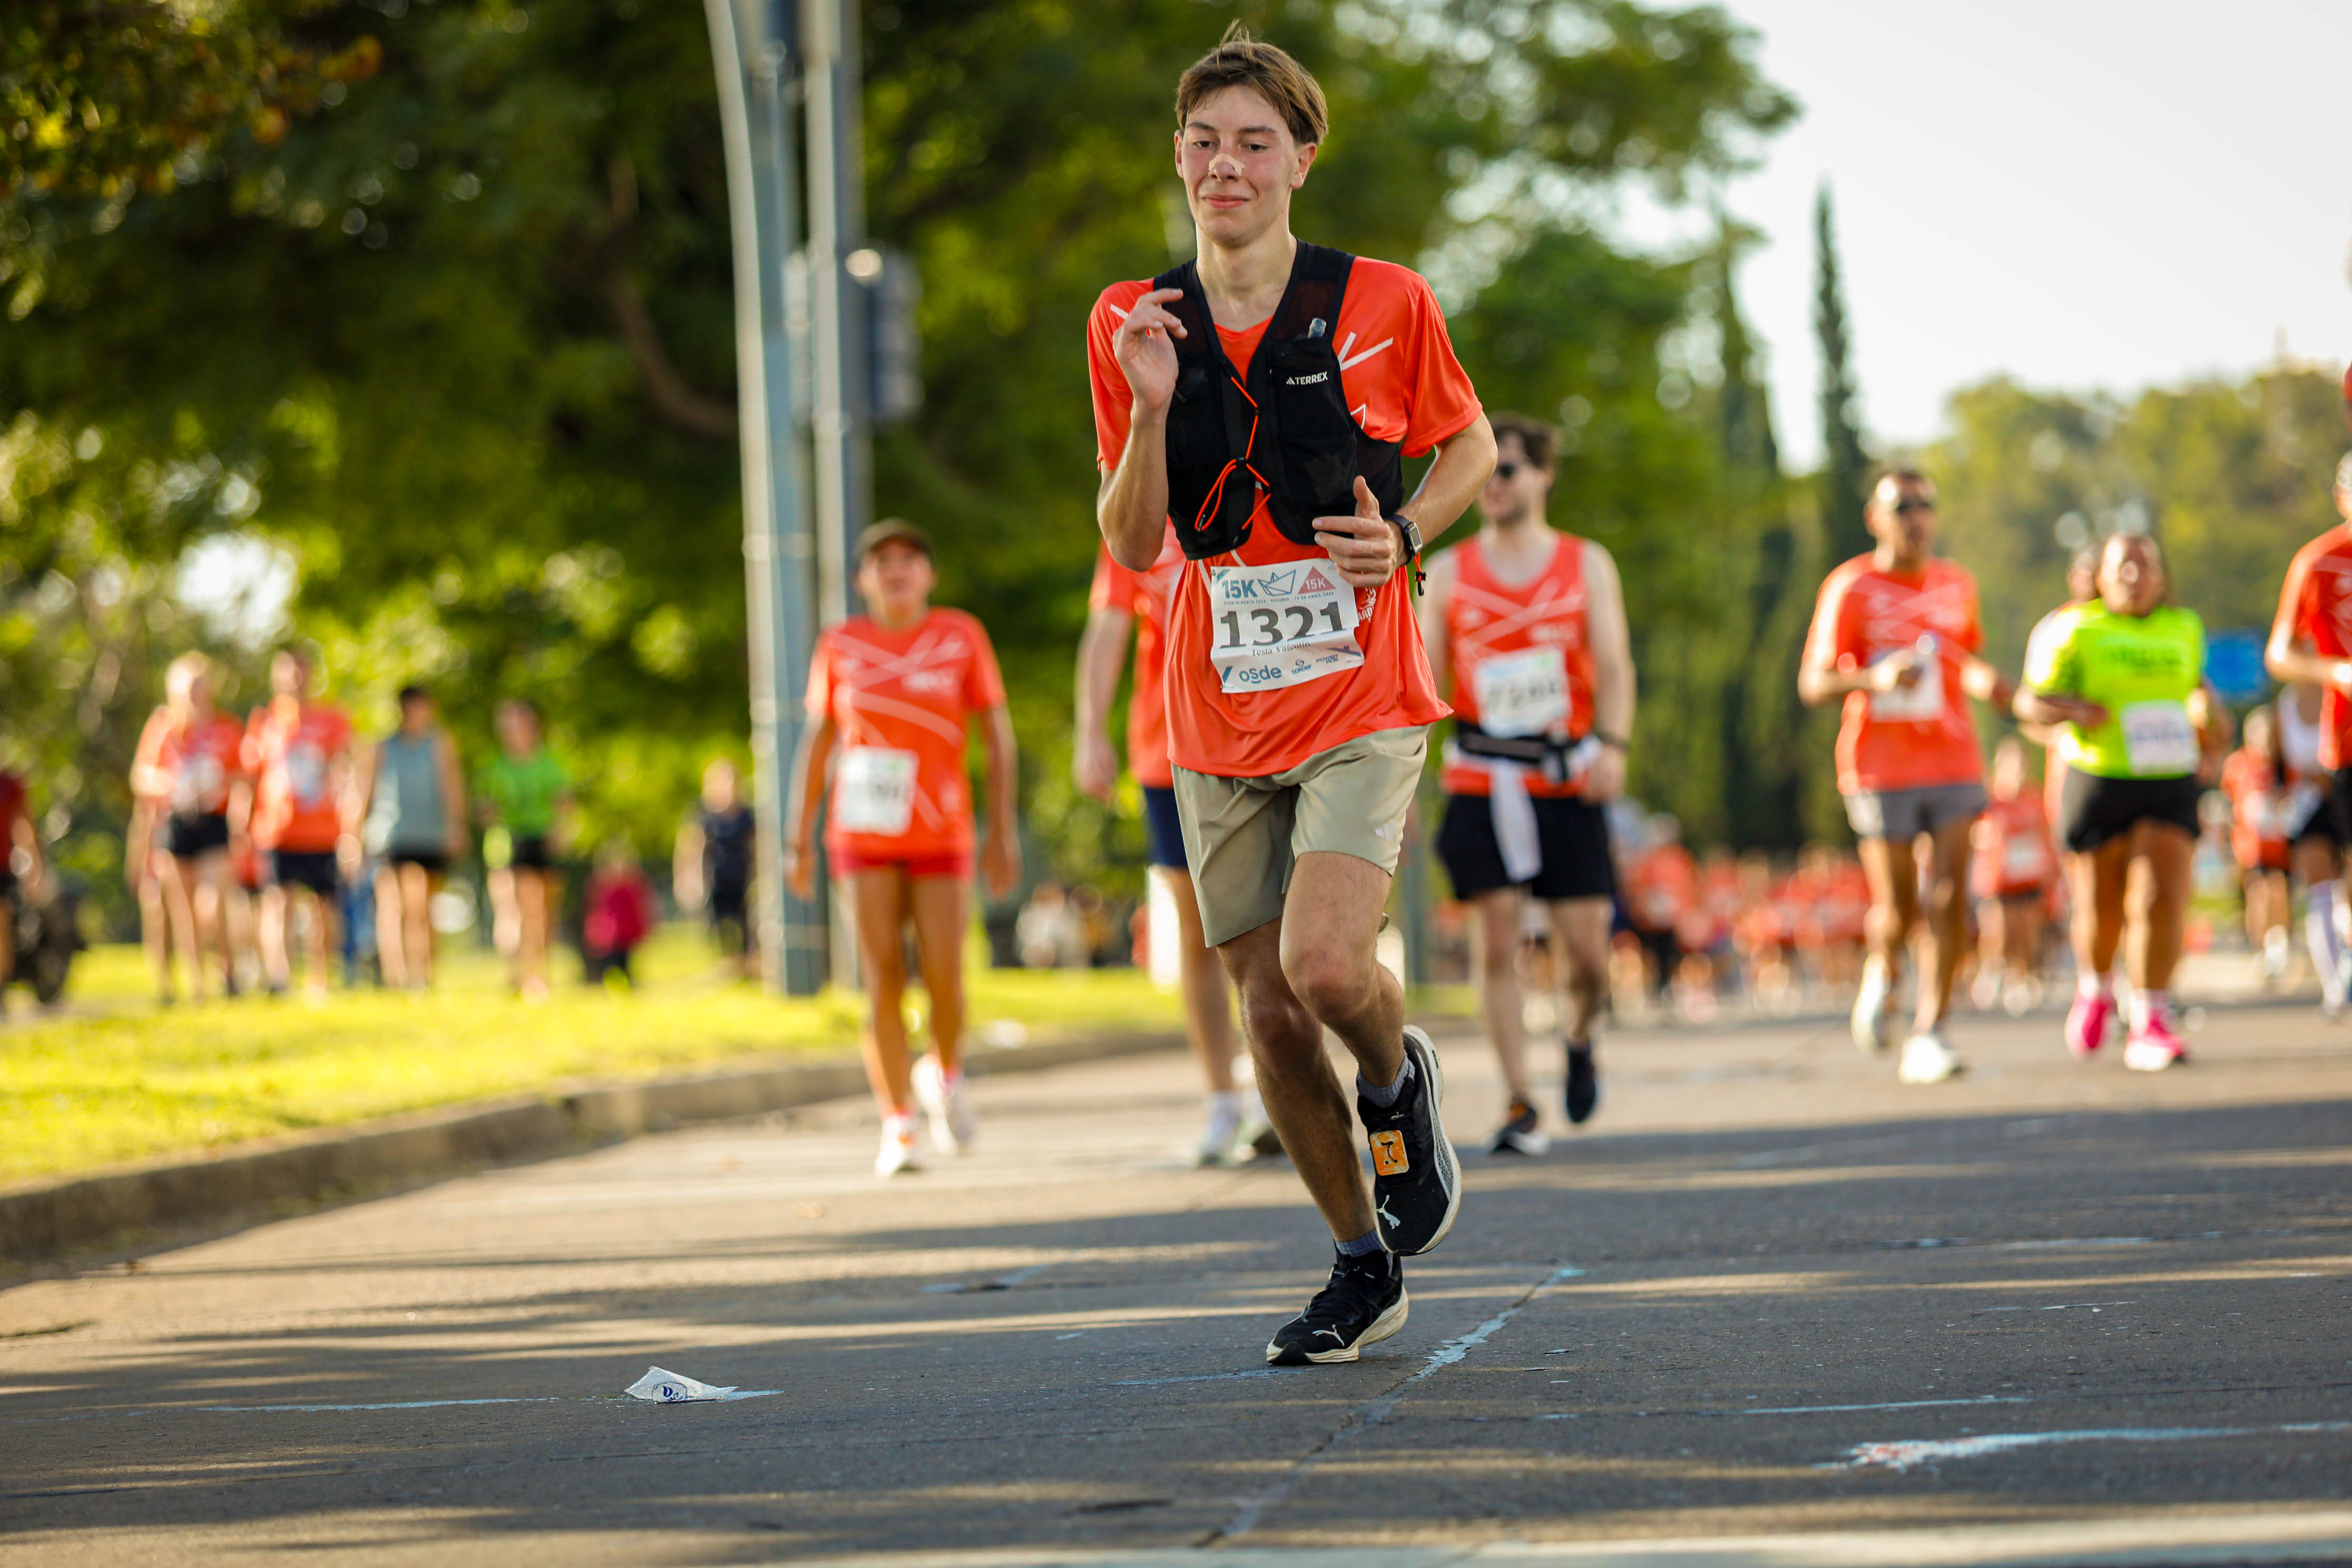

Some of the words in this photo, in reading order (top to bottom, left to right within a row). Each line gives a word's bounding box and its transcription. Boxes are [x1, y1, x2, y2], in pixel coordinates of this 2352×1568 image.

[1295, 371, 1328, 386] TERREX
[1222, 579, 1258, 599] 15K
[1305, 577, 1326, 591] 15K
[1220, 601, 1347, 649] 1321
[1239, 665, 1281, 683] osde
